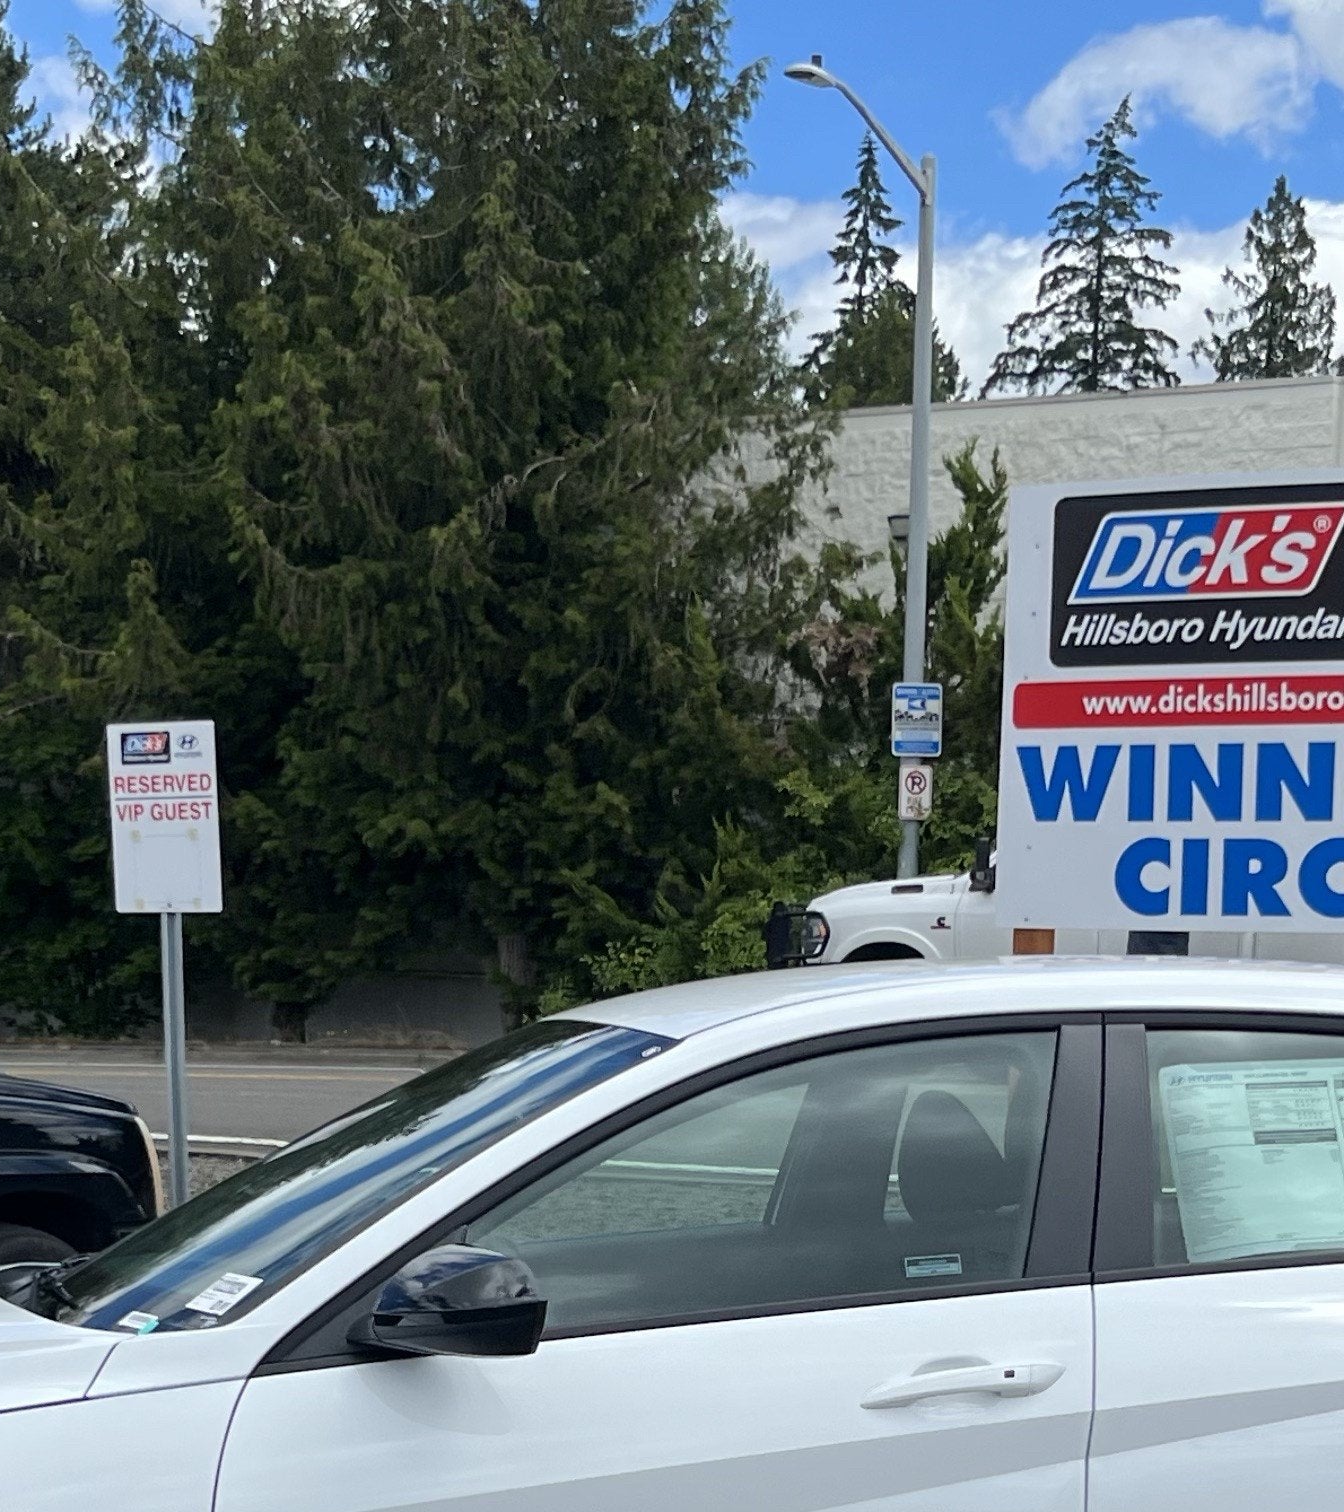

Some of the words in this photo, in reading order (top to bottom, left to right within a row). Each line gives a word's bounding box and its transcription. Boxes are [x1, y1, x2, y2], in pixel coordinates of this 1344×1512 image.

[1060, 612, 1205, 647] Hillsboro
[114, 774, 212, 794] RESERVED
[116, 804, 144, 821] VIP
[150, 802, 212, 821] GUEST
